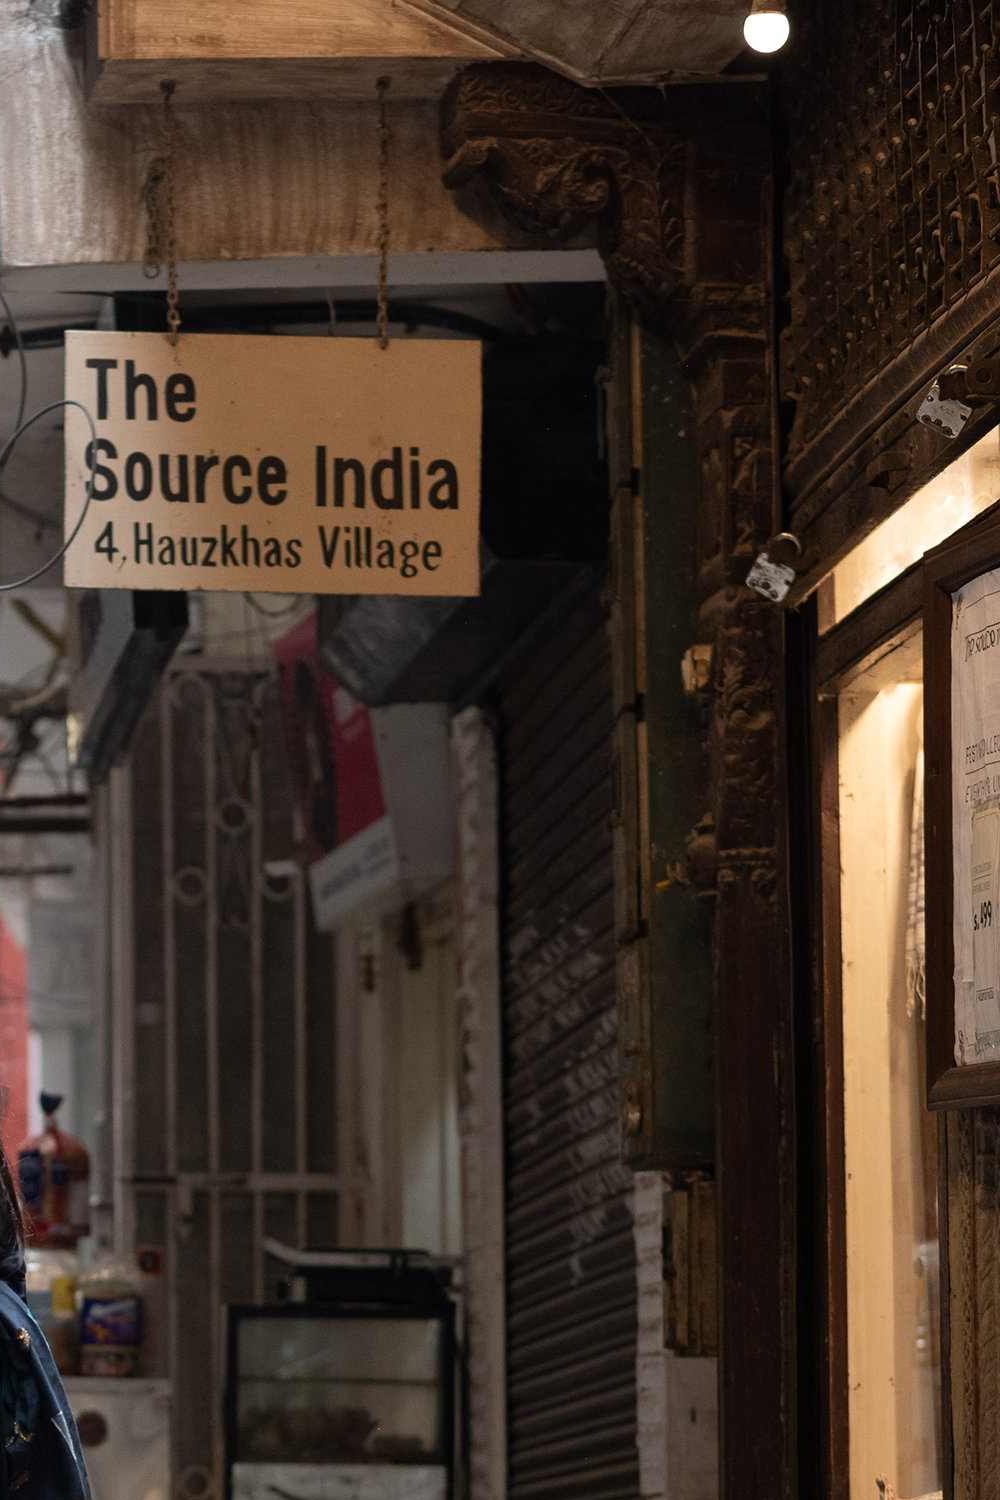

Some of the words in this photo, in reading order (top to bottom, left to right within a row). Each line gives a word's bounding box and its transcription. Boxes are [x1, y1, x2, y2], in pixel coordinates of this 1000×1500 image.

[85, 357, 197, 422] The
[84, 438, 288, 506] Source
[315, 445, 460, 511] India
[133, 521, 304, 568] Hauzkhas
[317, 525, 443, 578] Village
